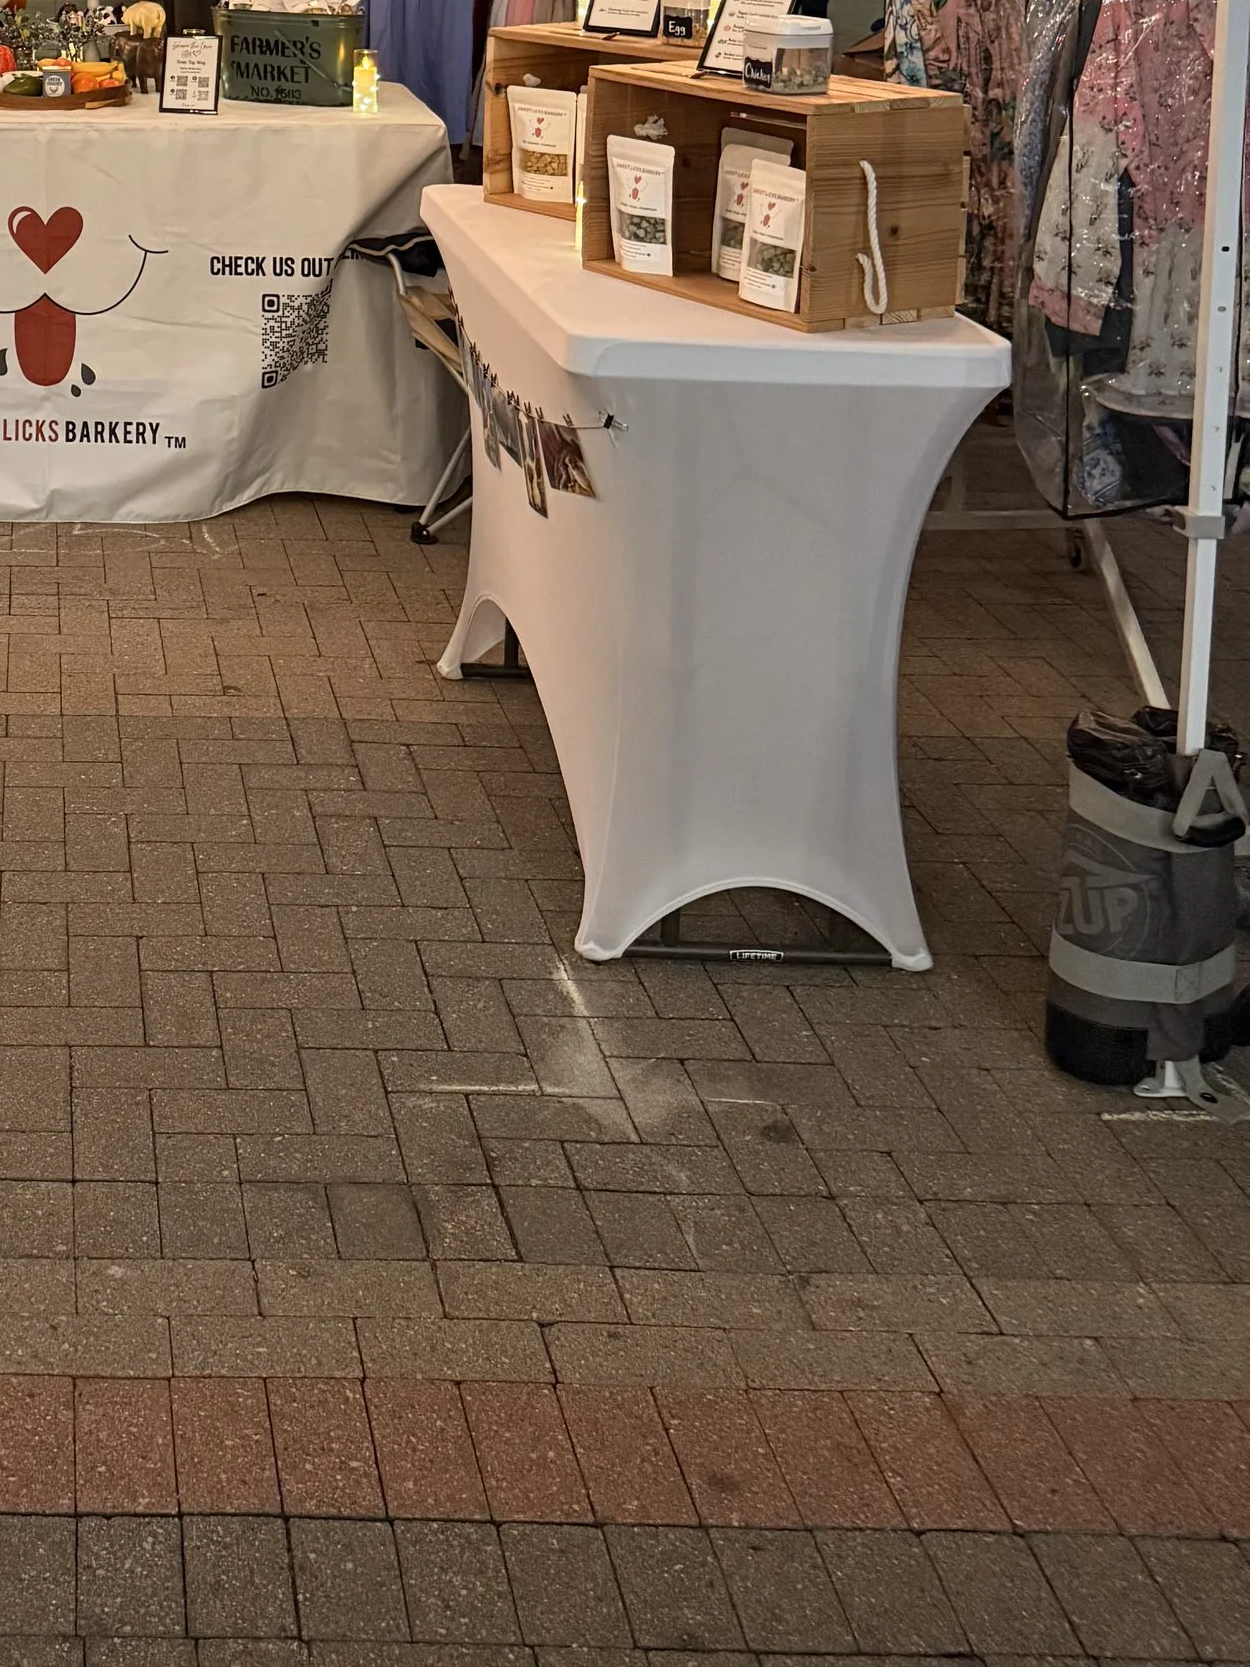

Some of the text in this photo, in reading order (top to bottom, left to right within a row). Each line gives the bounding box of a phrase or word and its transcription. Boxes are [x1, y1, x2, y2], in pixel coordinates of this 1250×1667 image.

[668, 20, 686, 36] Egg
[230, 35, 321, 60] FARMER'S
[235, 60, 310, 84] MARKET
[209, 255, 335, 279] CHECK US OUT
[2, 419, 60, 444] LICKS
[64, 421, 161, 446] BARKERY
[164, 436, 187, 450] TM
[736, 952, 778, 960] LIFETIME
